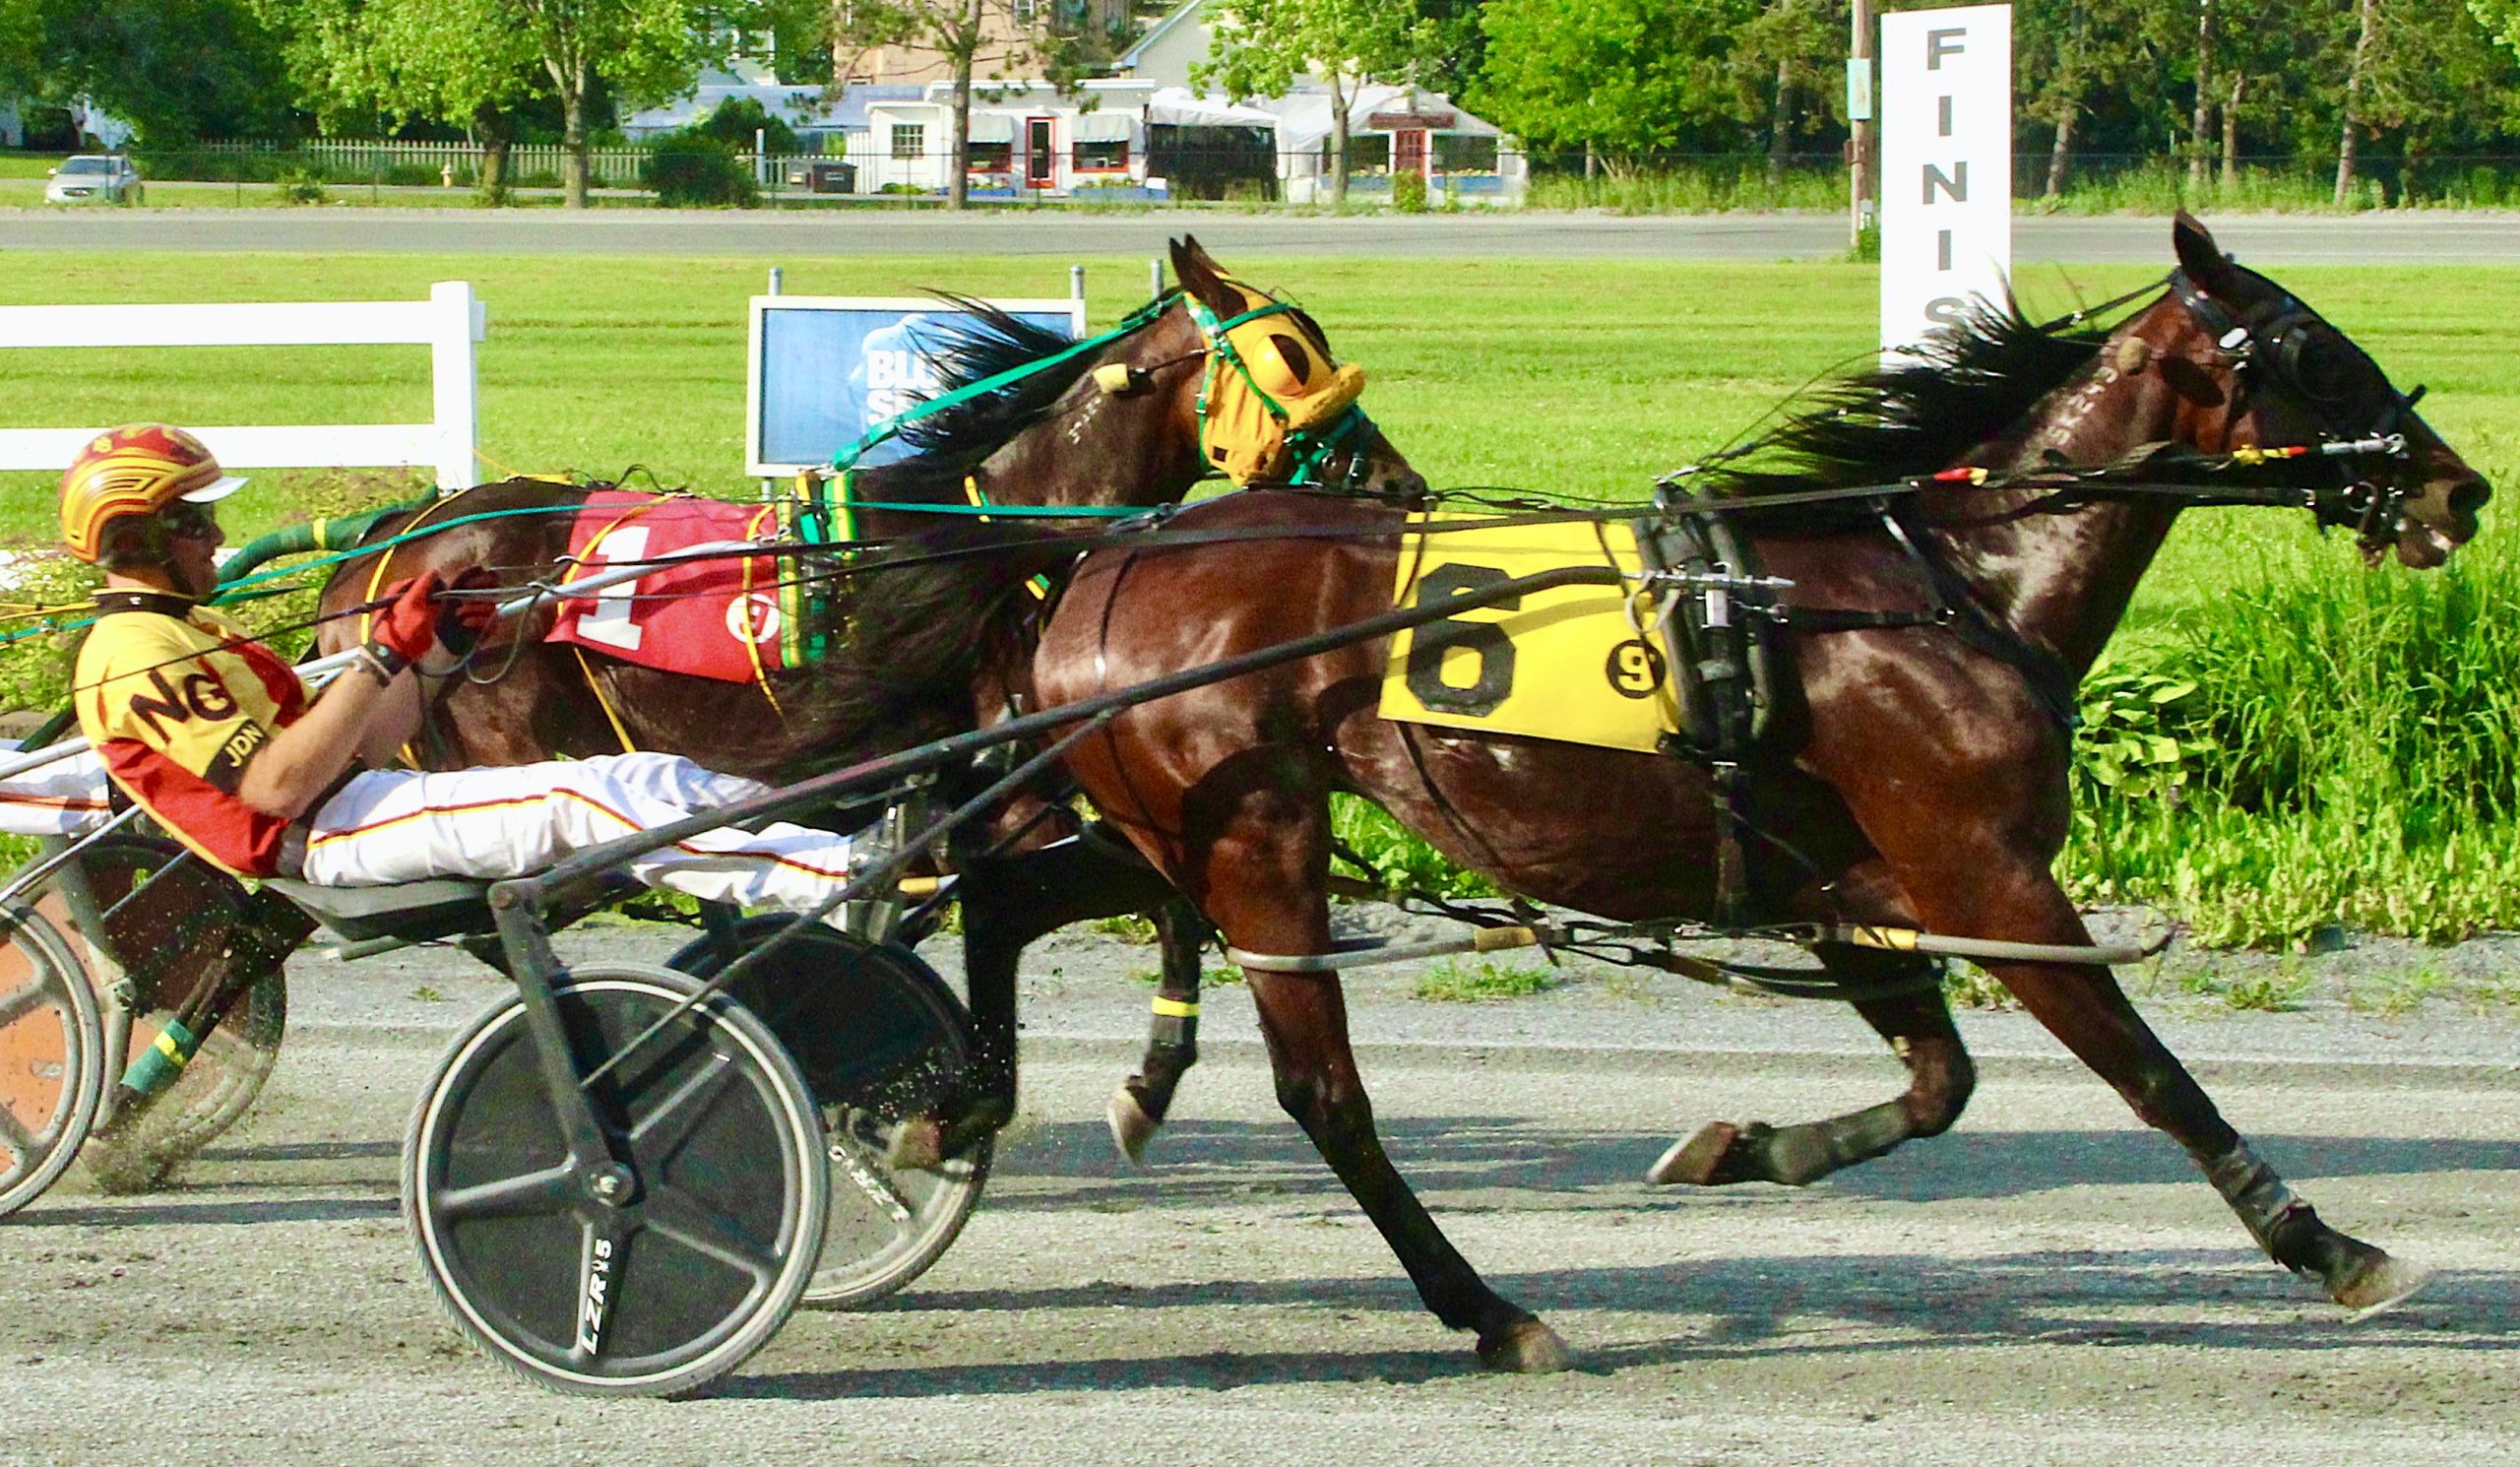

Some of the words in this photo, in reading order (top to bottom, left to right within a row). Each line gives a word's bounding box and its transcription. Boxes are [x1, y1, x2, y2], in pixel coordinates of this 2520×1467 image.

[866, 349, 953, 390] BLU
[577, 526, 651, 651] 1
[1406, 562, 1522, 718] 6
[130, 668, 238, 745] NG
[224, 723, 264, 768] JDN
